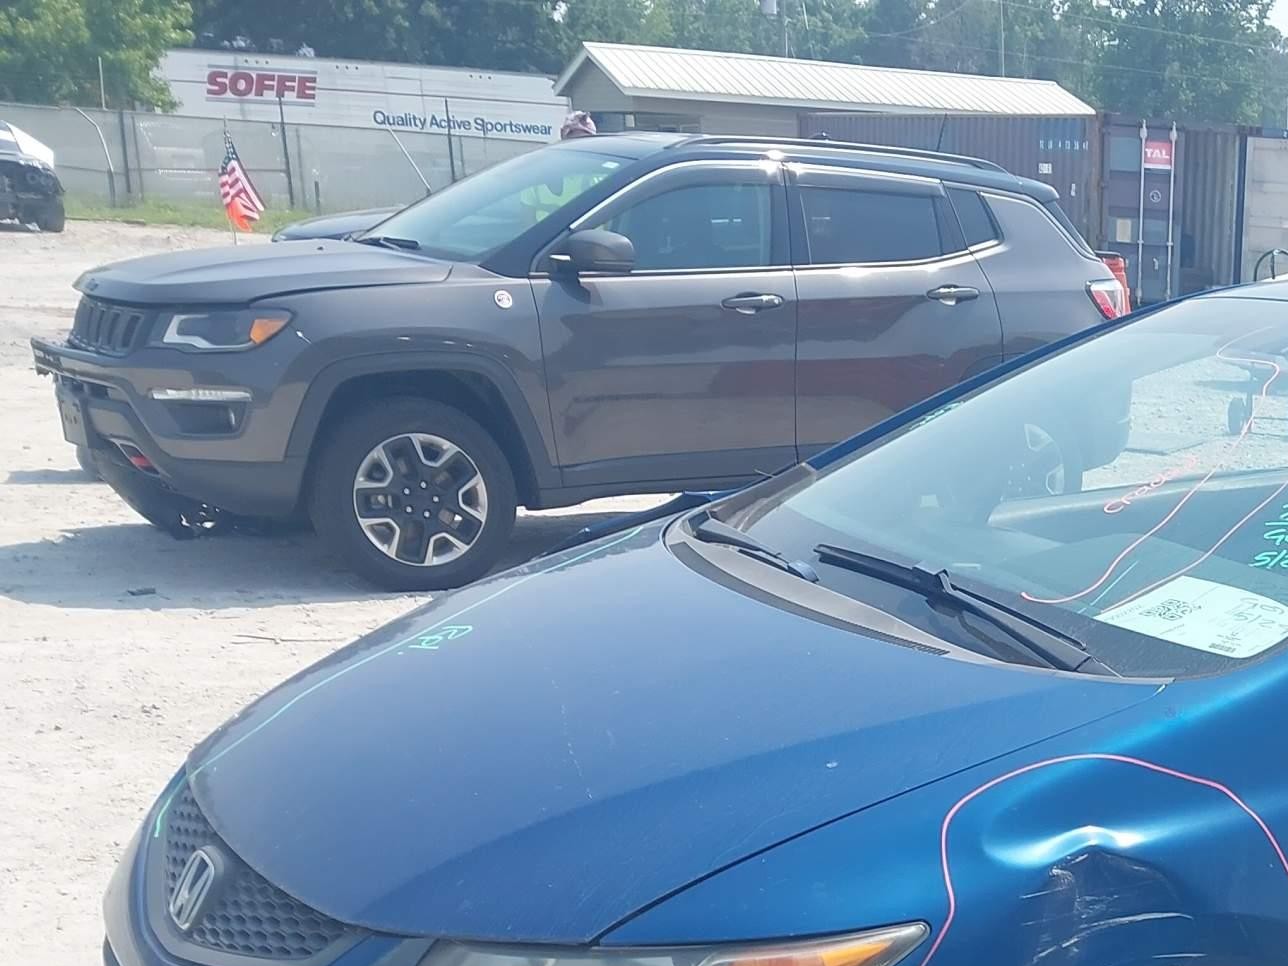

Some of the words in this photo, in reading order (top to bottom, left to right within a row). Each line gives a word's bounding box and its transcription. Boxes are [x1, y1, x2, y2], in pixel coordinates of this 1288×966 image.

[206, 71, 317, 100] SOFFE
[373, 110, 427, 130] Quality
[429, 115, 472, 131] Active
[474, 117, 552, 136] Sportswear
[1145, 148, 1170, 159] TAL
